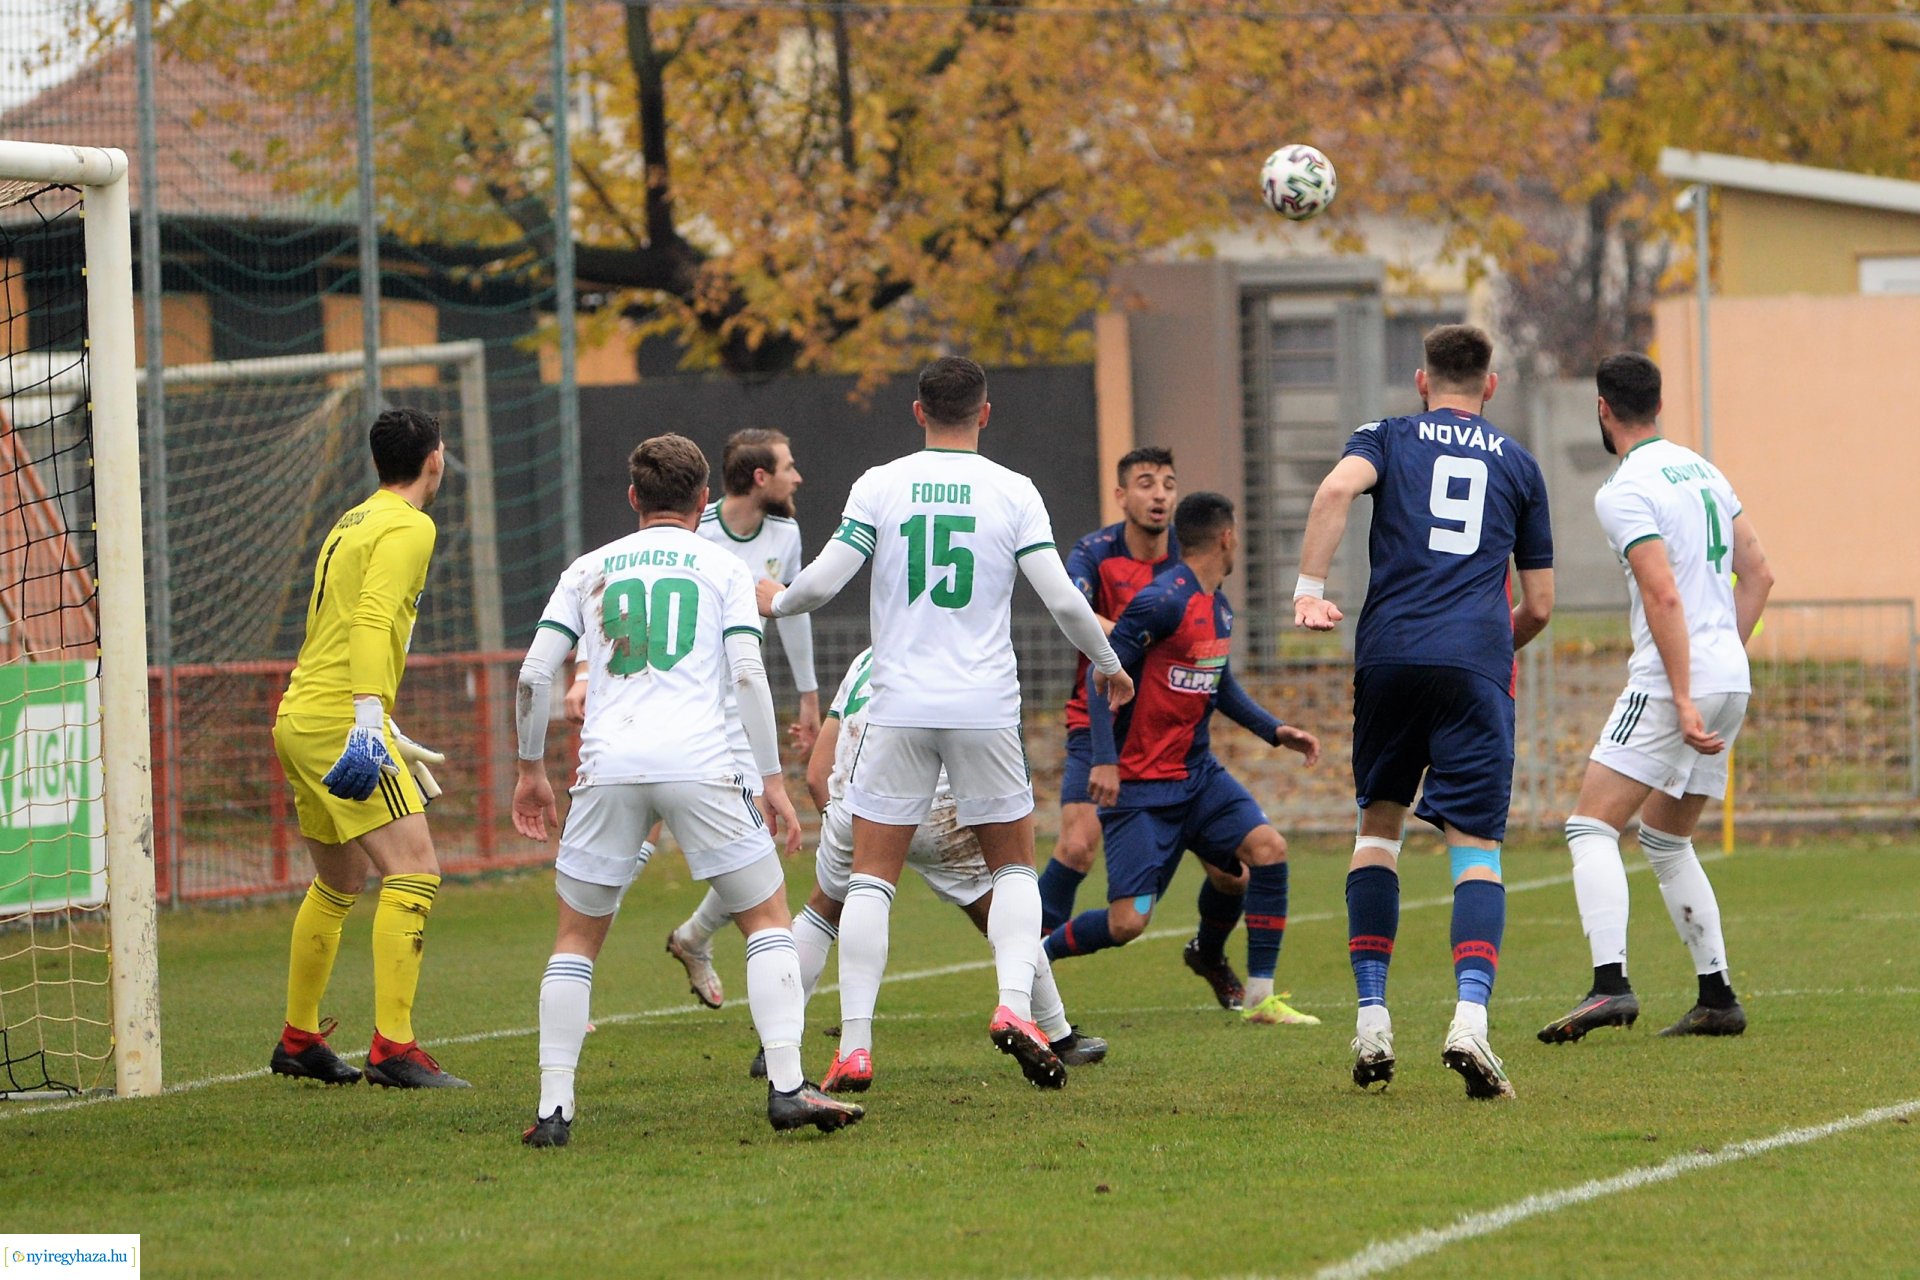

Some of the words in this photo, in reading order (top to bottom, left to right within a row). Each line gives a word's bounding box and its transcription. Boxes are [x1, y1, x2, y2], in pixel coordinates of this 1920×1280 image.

[1418, 420, 1505, 457] NOVÁK
[911, 482, 972, 505] FODOR
[1428, 454, 1489, 556] 9
[1700, 488, 1728, 574] 4
[315, 535, 343, 616] 1
[683, 553, 701, 572] K.
[899, 514, 977, 610] 15
[601, 577, 700, 676] 90
[20, 731, 77, 799] LIGA
